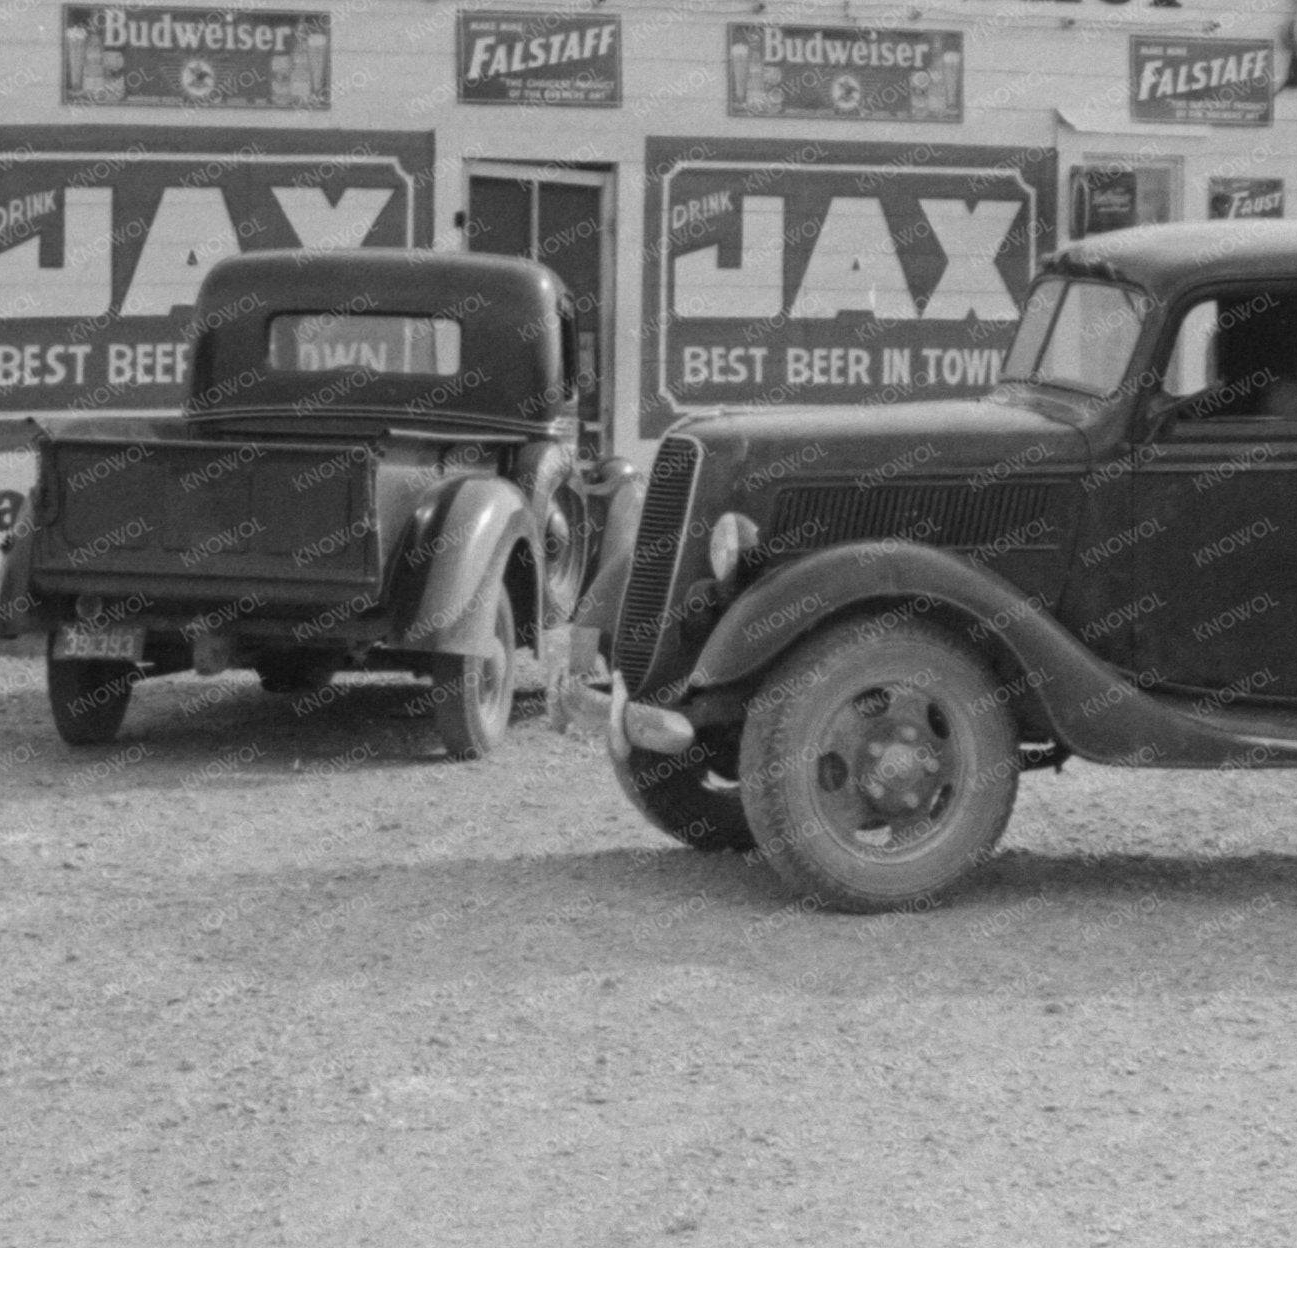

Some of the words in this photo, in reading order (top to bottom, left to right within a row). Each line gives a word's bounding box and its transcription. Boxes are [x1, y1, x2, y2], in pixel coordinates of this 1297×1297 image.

[104, 9, 291, 51] Budweiser
[763, 27, 930, 68] Budweiser
[467, 24, 616, 80] FALSTAFF
[1137, 50, 1269, 101] FALSTAFF
[672, 190, 734, 231] DRINK
[1227, 191, 1282, 219] FAUST
[673, 195, 1023, 321] JAX
[683, 346, 768, 384] BEST
[785, 347, 871, 385] BEER
[882, 348, 911, 385] IN
